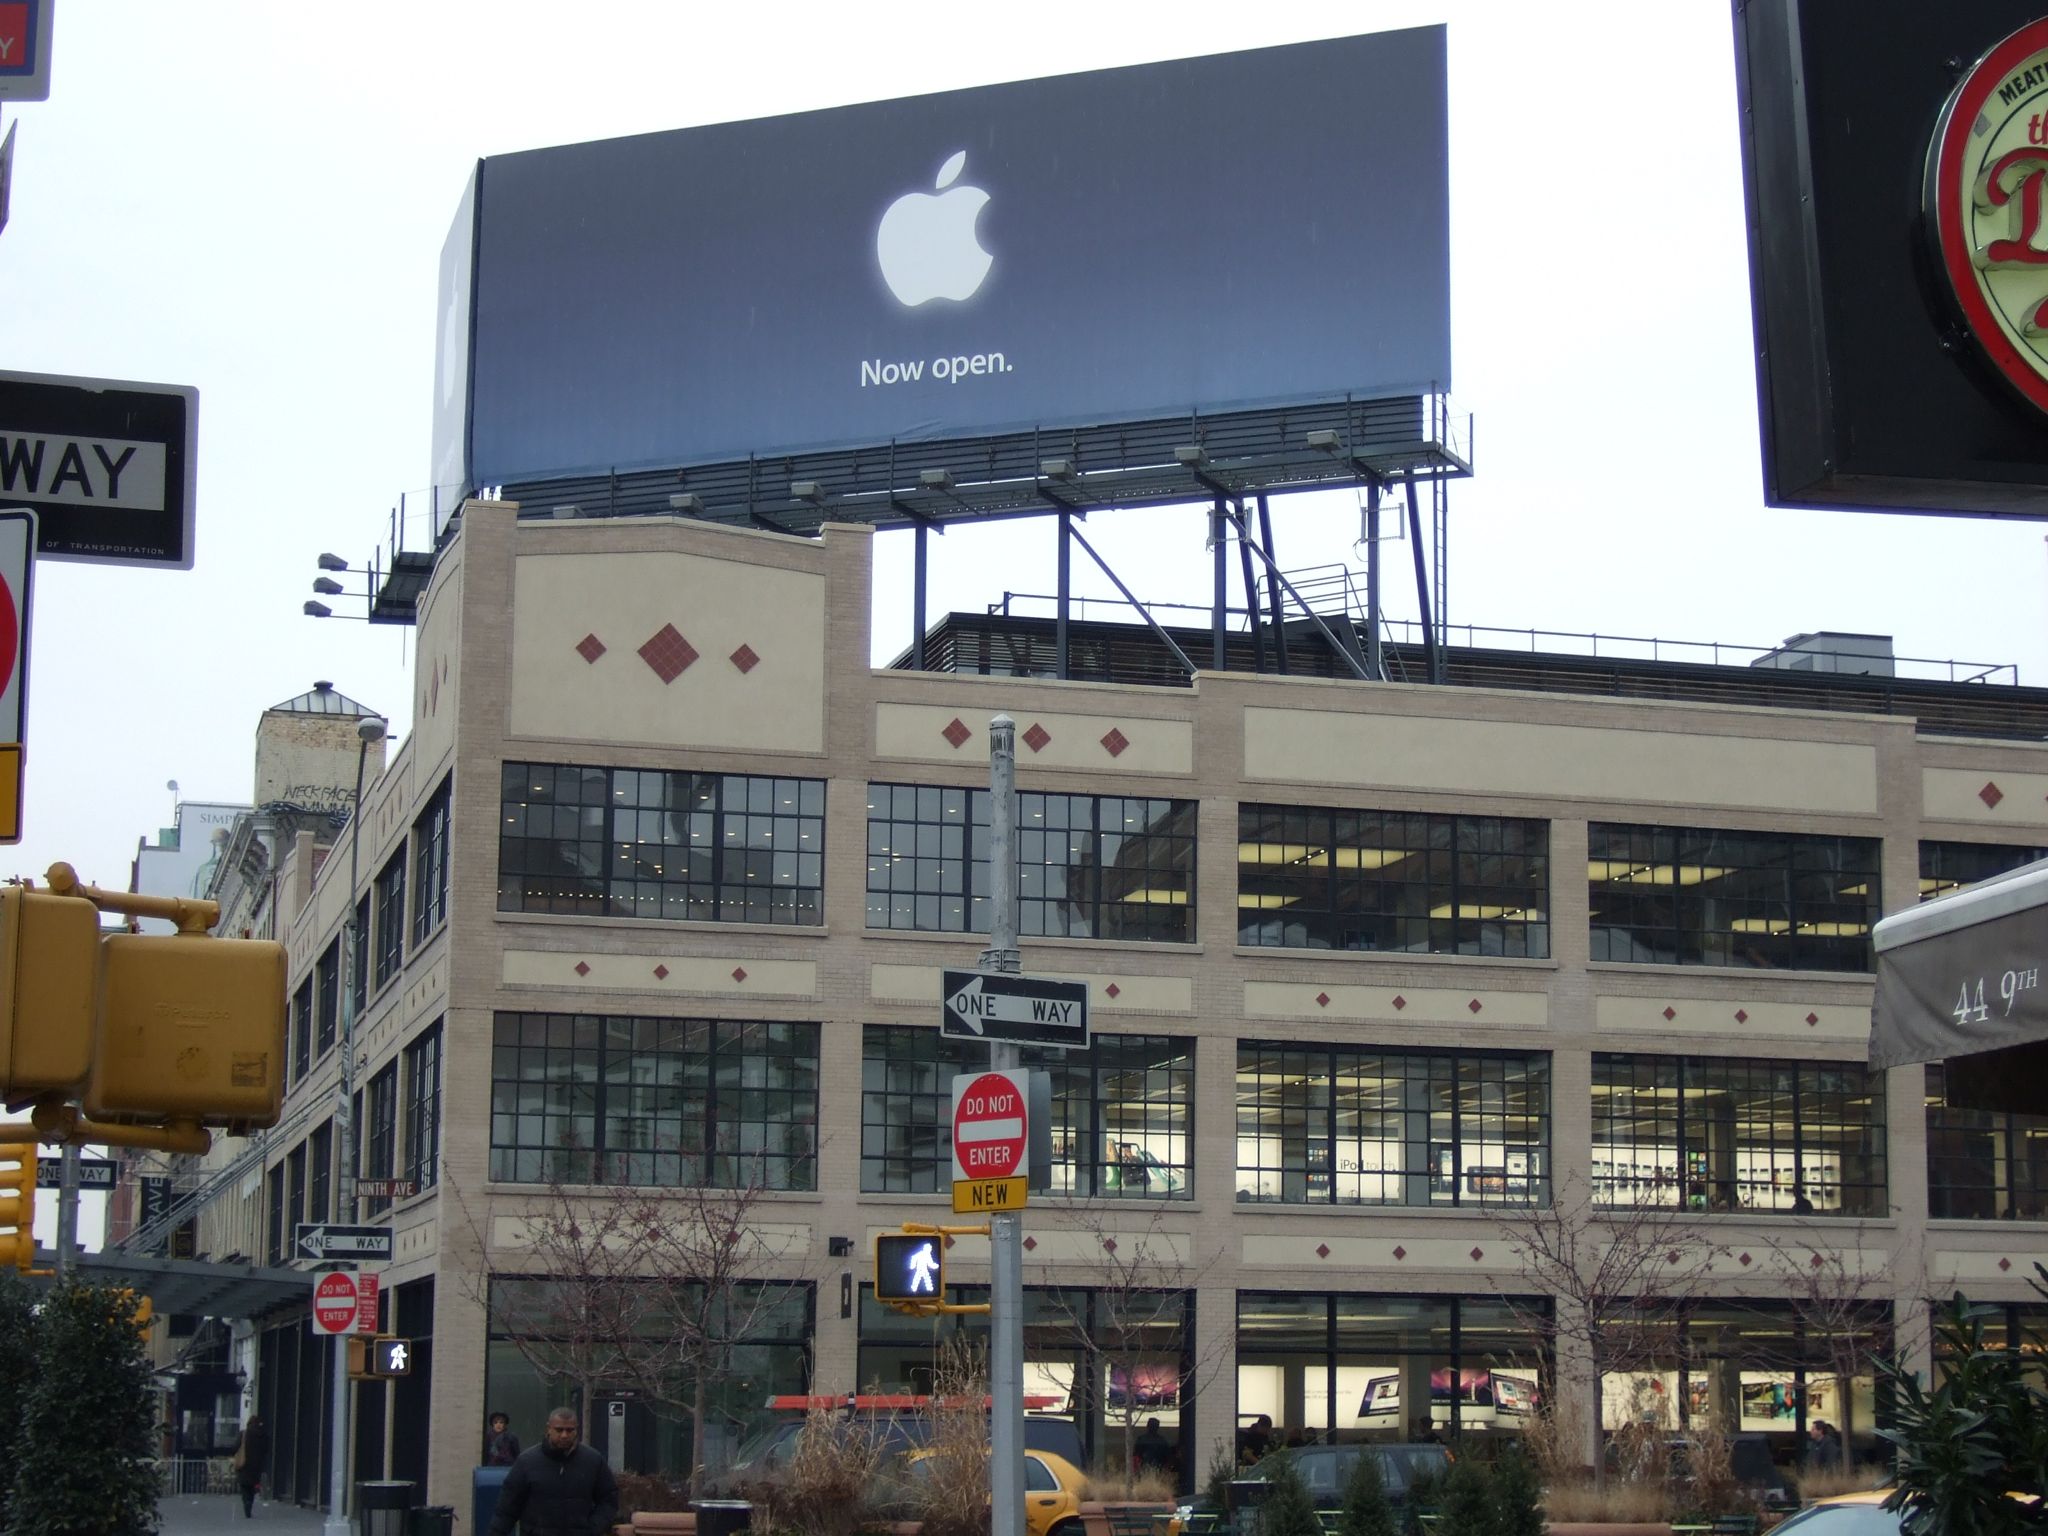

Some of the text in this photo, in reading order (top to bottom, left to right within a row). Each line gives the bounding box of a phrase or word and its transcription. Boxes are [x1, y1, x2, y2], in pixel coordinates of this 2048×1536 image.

[1998, 60, 2048, 107] MEAT
[861, 352, 1013, 387] Now open.
[0, 436, 137, 499] WAY
[46, 540, 165, 556] OF TRANSPORTATION
[200, 812, 237, 825] SIMP
[1953, 968, 2039, 1026] 44 9TH
[956, 993, 1073, 1024] ONE WAY
[967, 1094, 1015, 1116] DO NOT
[969, 1146, 1011, 1166] ENTER
[36, 1167, 61, 1179] ONE
[358, 1181, 414, 1196] NINTH AVE
[972, 1184, 1008, 1206] NEW
[305, 1236, 384, 1250] ONE WAY
[322, 1284, 334, 1295] DO
[335, 1283, 351, 1294] NOT
[323, 1310, 349, 1321] ENTER
